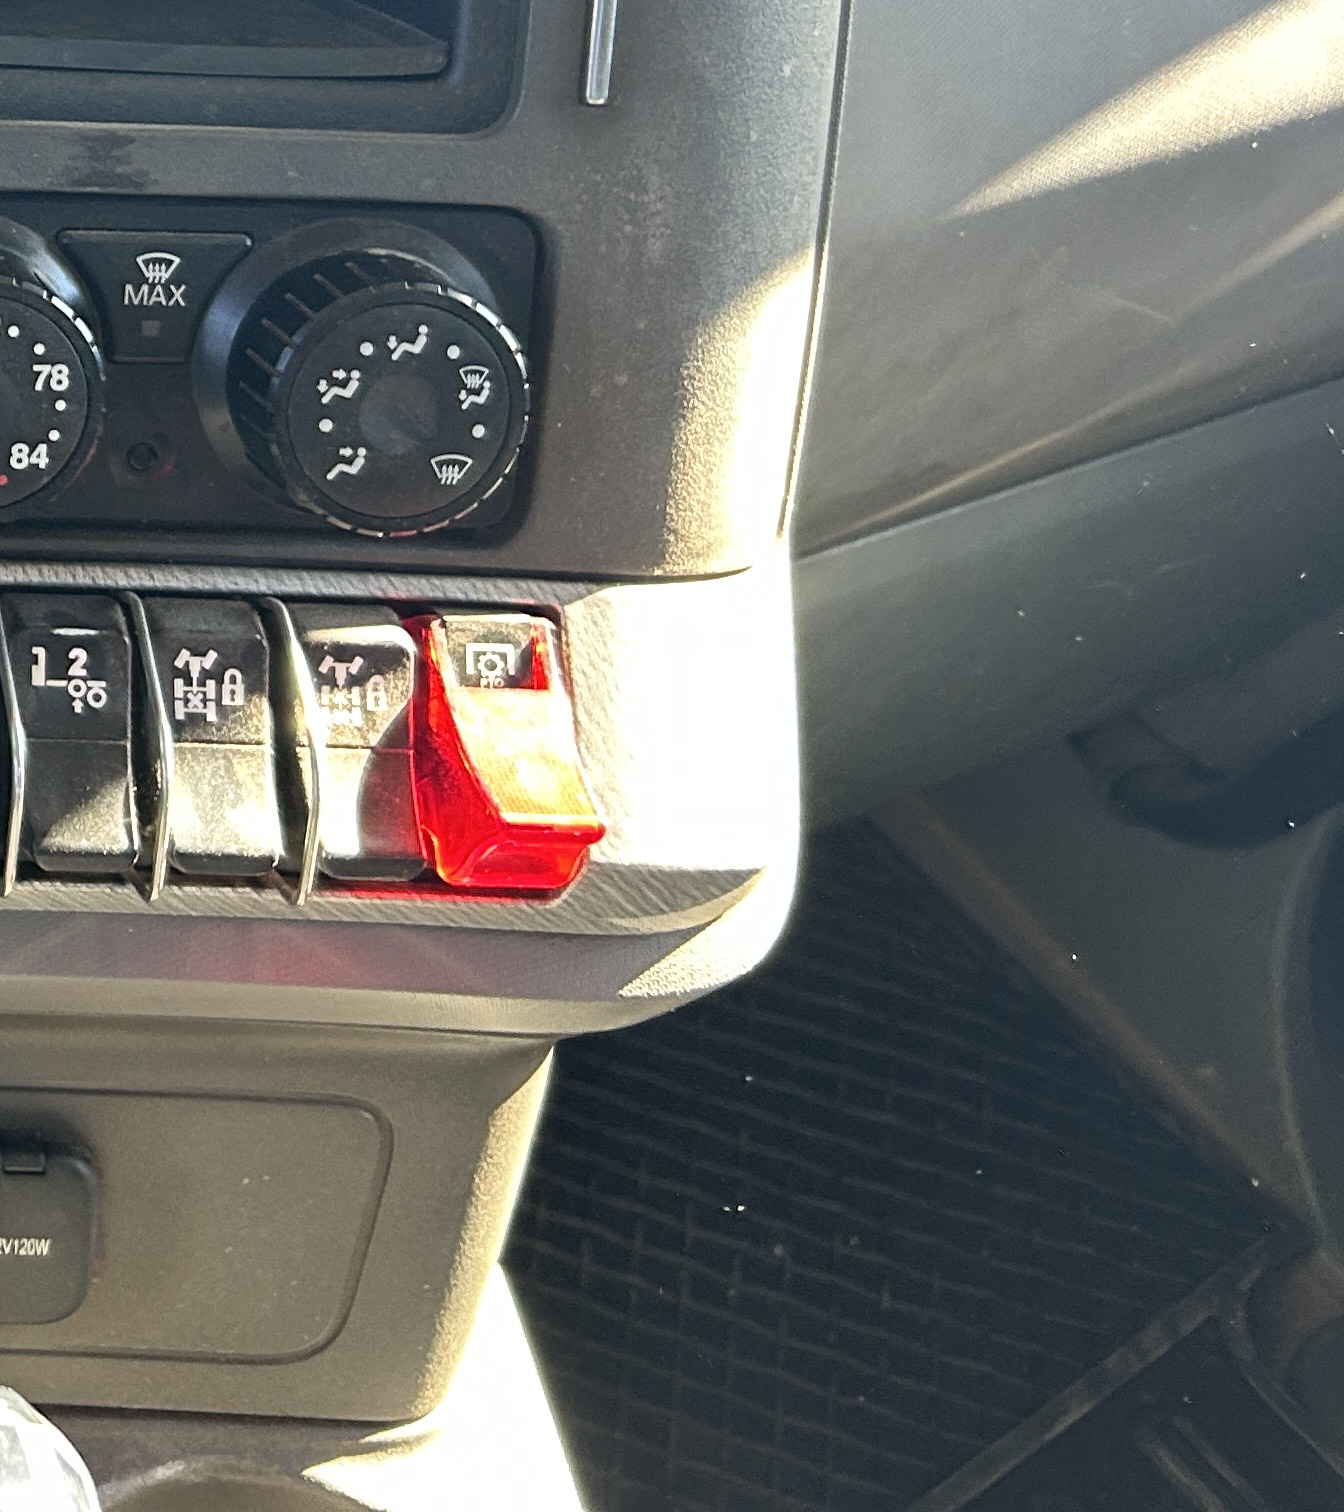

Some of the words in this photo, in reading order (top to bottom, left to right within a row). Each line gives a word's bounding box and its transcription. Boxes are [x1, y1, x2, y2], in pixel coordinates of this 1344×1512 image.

[123, 284, 186, 307] MAX
[32, 364, 69, 392] 78
[10, 443, 49, 470] 84
[68, 648, 87, 675] 2
